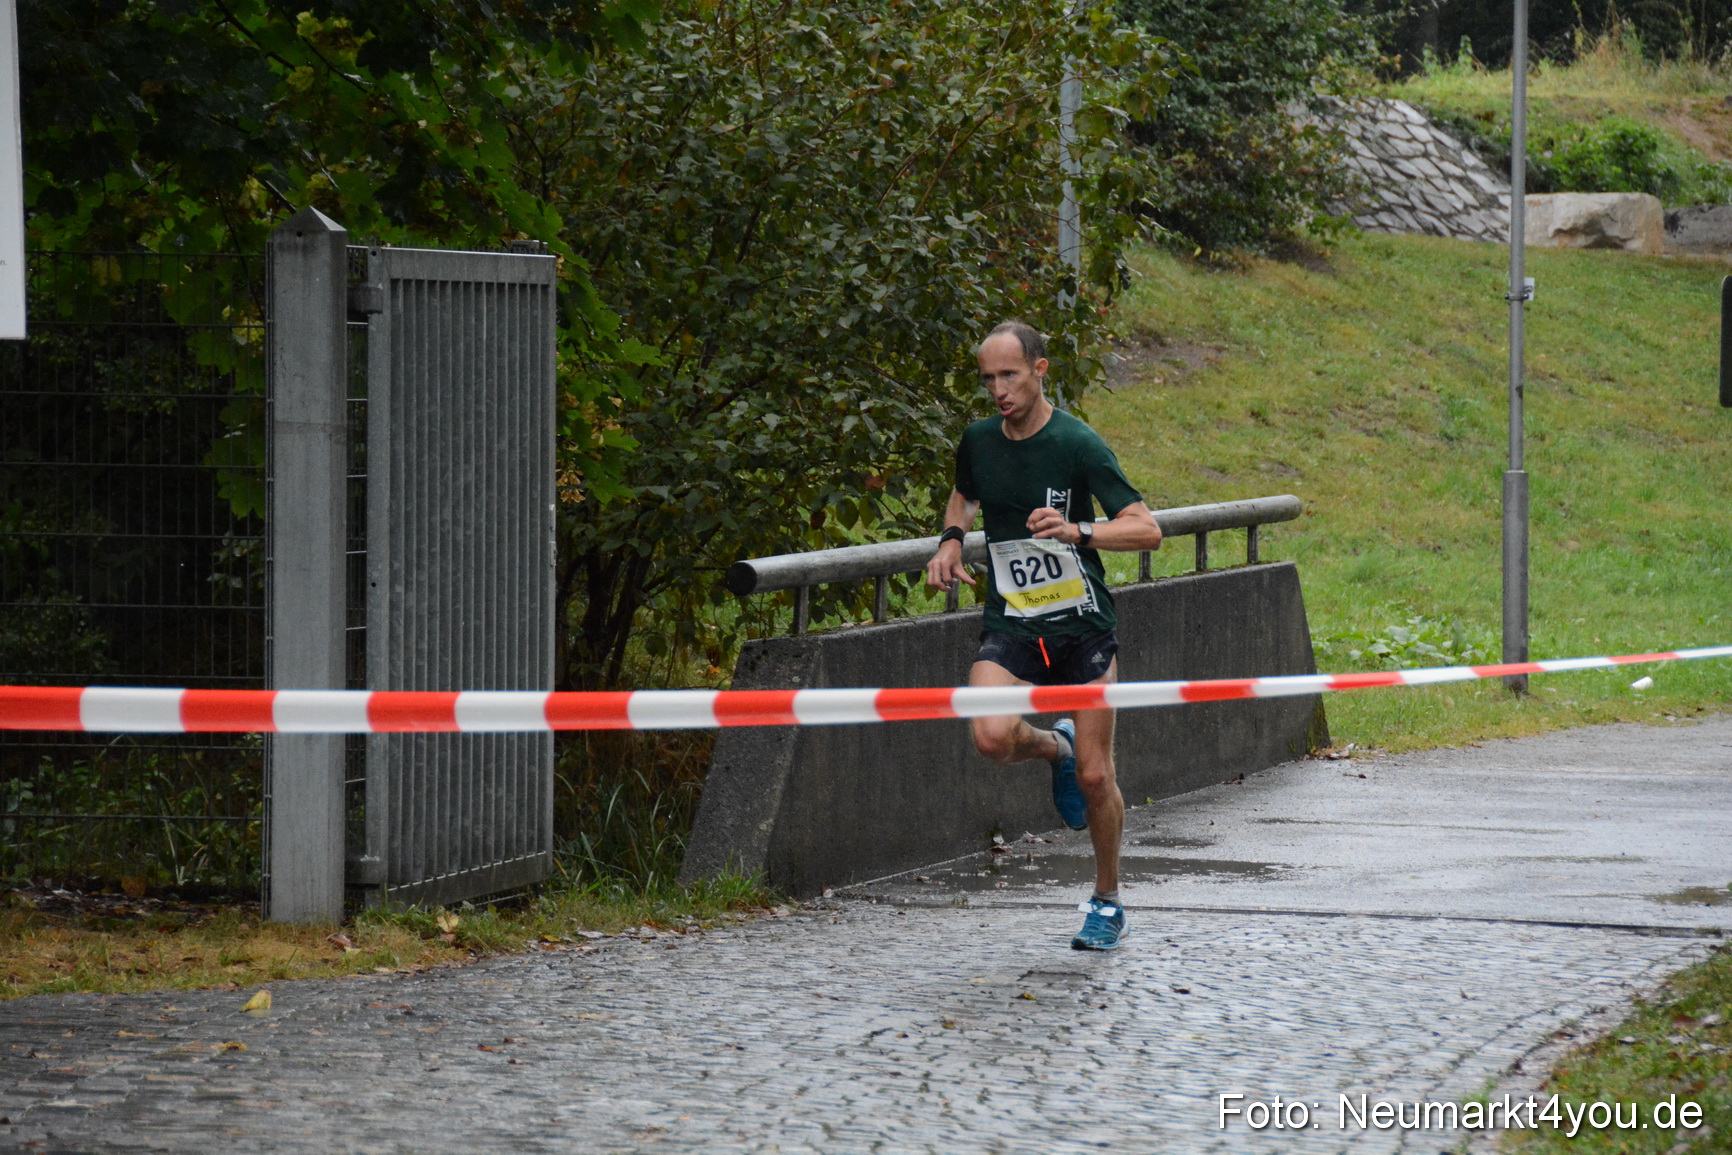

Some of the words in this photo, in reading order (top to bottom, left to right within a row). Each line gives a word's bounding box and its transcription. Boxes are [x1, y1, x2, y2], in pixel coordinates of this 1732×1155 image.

[1052, 490, 1067, 506] 21.
[1009, 553, 1063, 588] 620
[1019, 592, 1061, 606] Thomas
